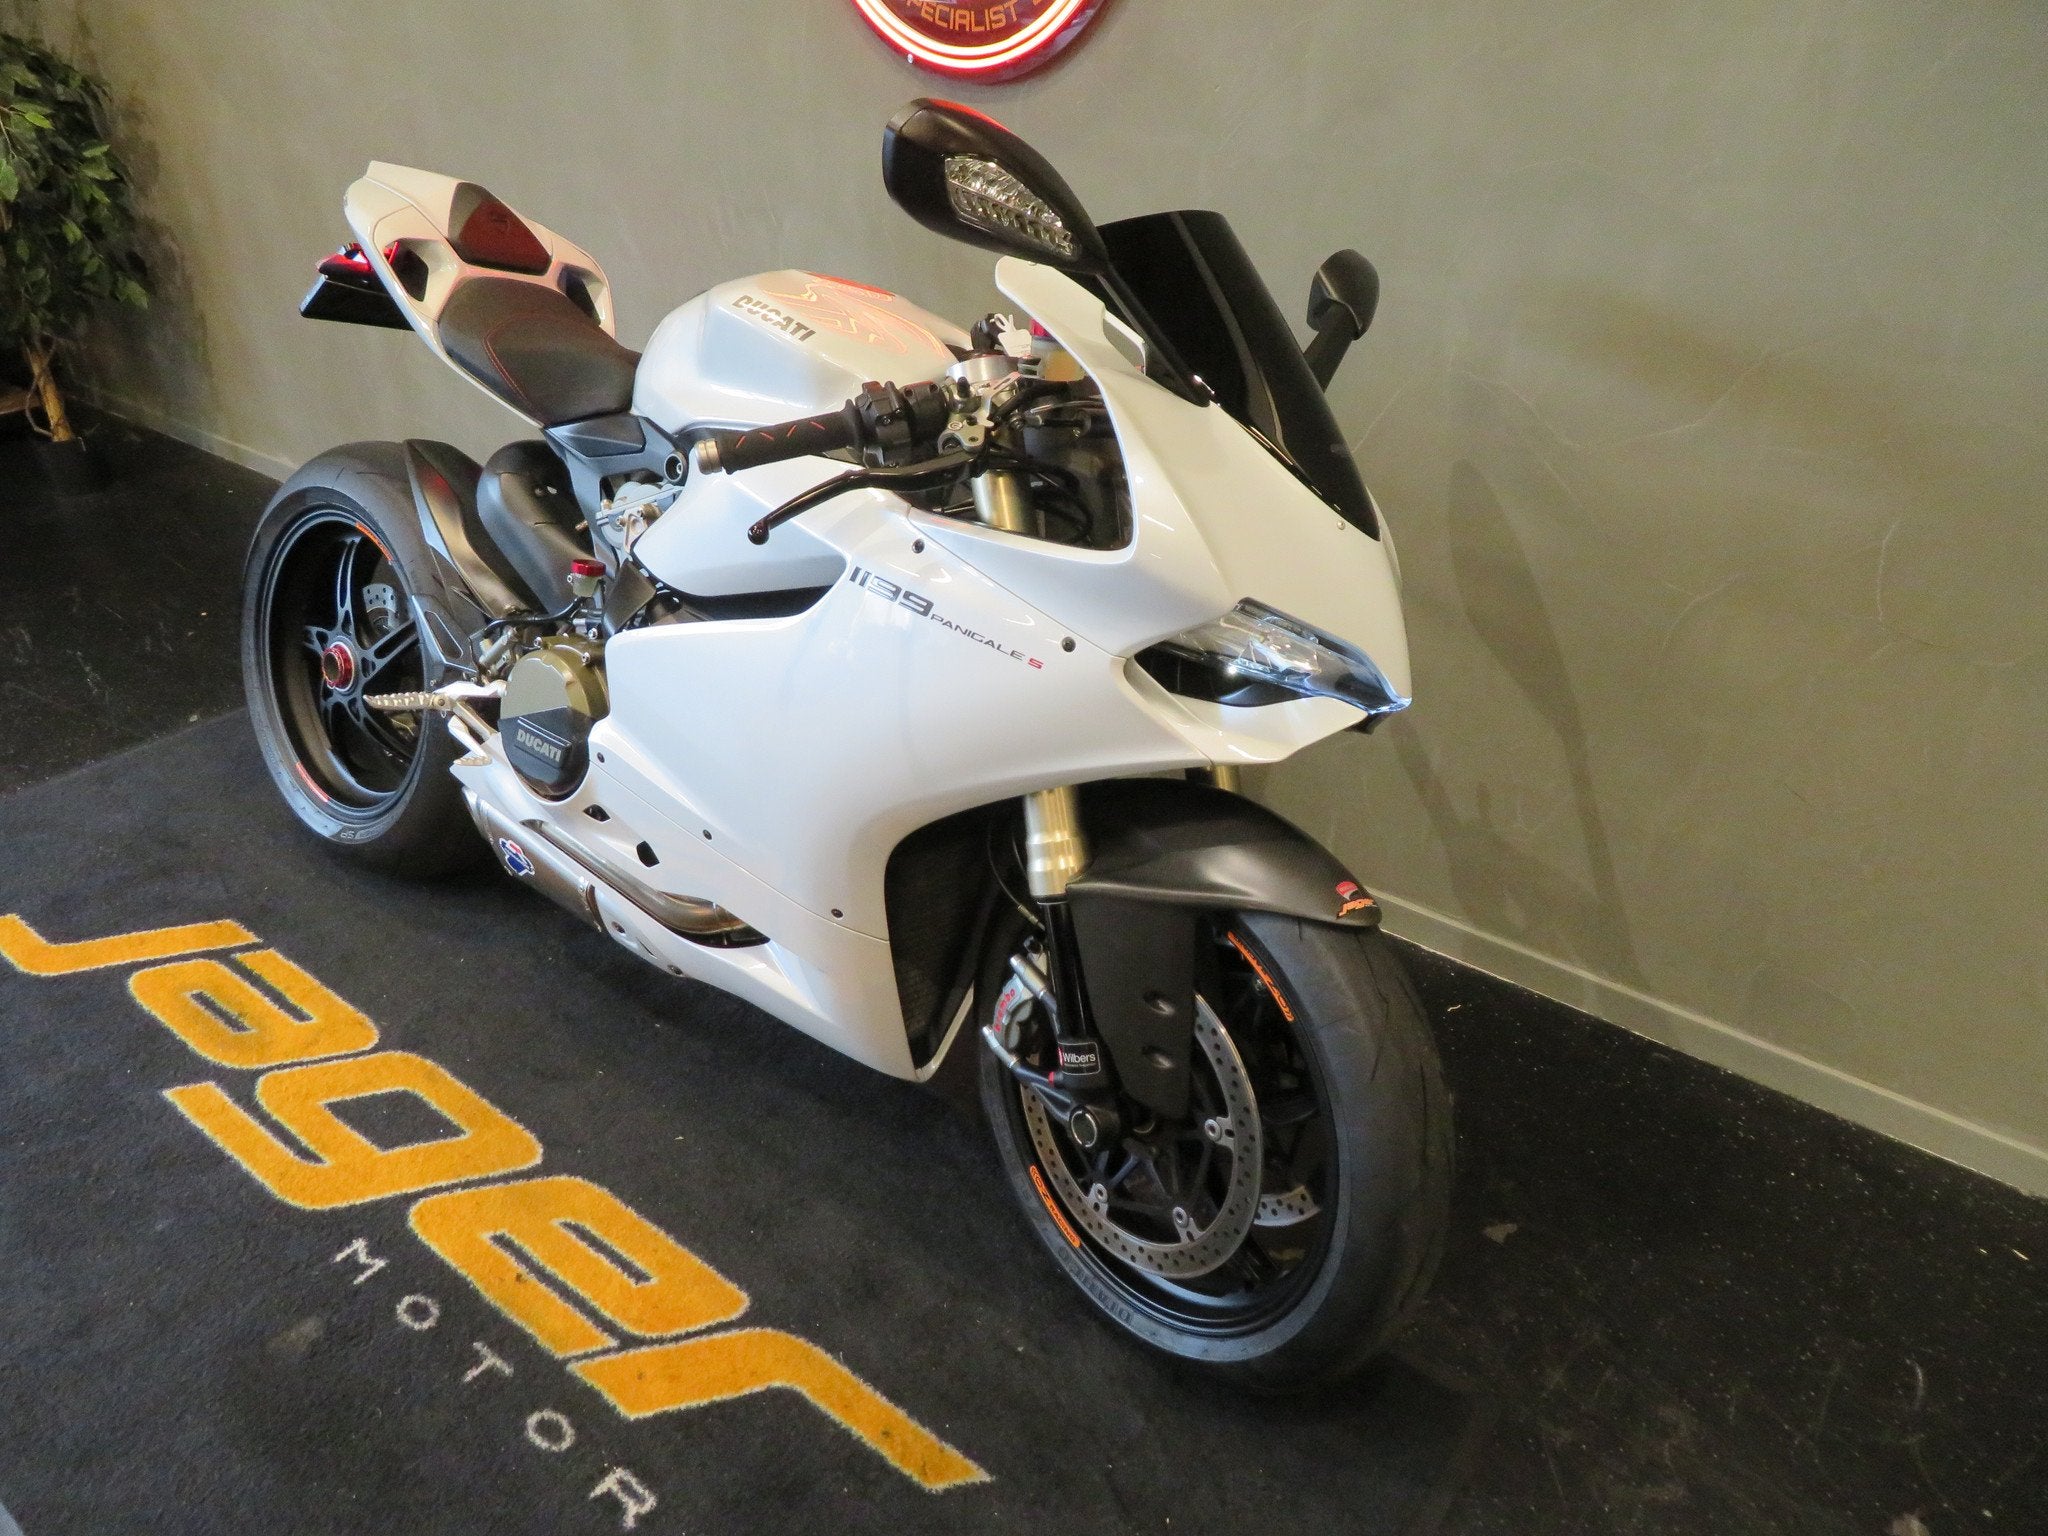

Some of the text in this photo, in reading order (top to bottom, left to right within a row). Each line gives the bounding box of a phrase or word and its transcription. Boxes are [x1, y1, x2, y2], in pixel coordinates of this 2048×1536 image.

[732, 295, 816, 342] DUCATI
[849, 566, 1044, 670] 1199 PANIGALE S
[516, 729, 562, 763] DUCATI
[1062, 1051, 1096, 1064] Wilbers
[332, 1234, 659, 1532] MOTOR
